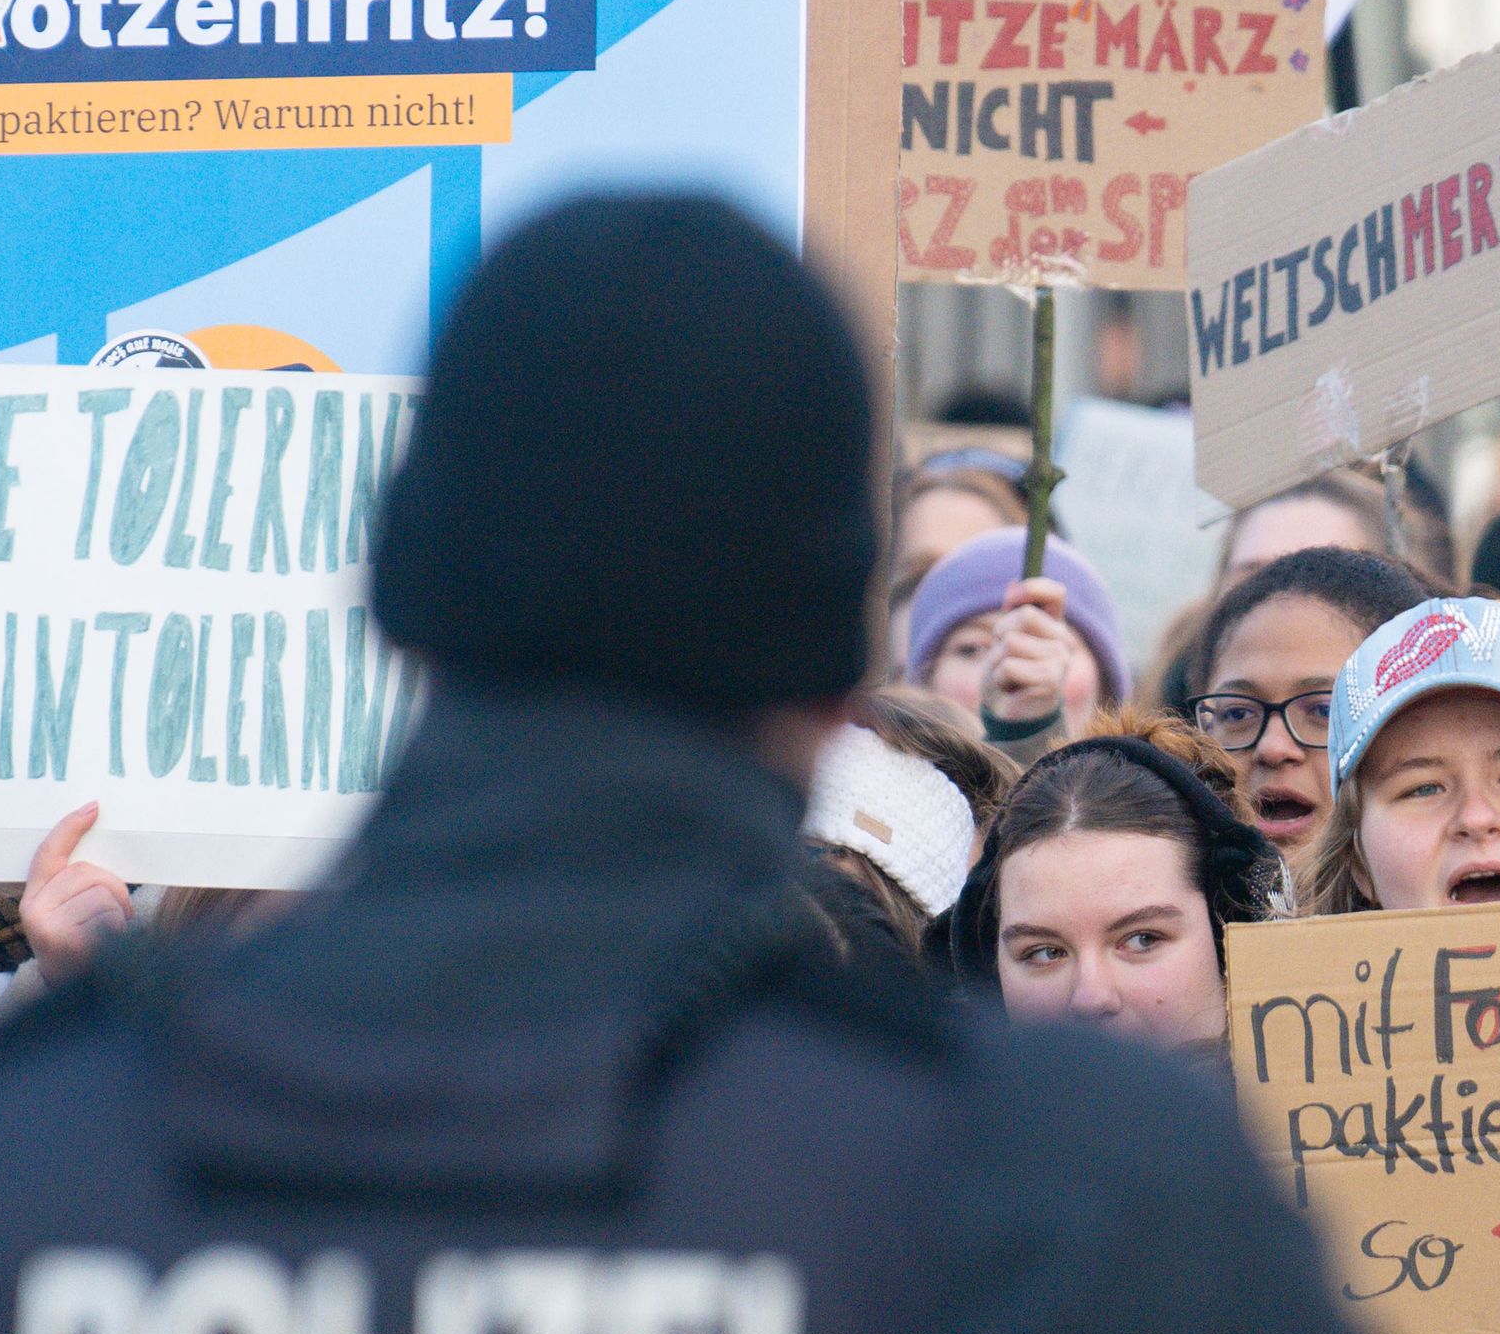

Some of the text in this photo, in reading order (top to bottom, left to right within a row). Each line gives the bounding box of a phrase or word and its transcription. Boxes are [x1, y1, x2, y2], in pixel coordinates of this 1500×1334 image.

[214, 94, 355, 133] Warum
[365, 90, 477, 131] nicht!
[901, 79, 1114, 163] NICHT
[1003, 174, 1089, 218] an
[1098, 171, 1200, 269] SP
[77, 385, 426, 575] TOLERAN
[1249, 948, 1414, 1085] mit
